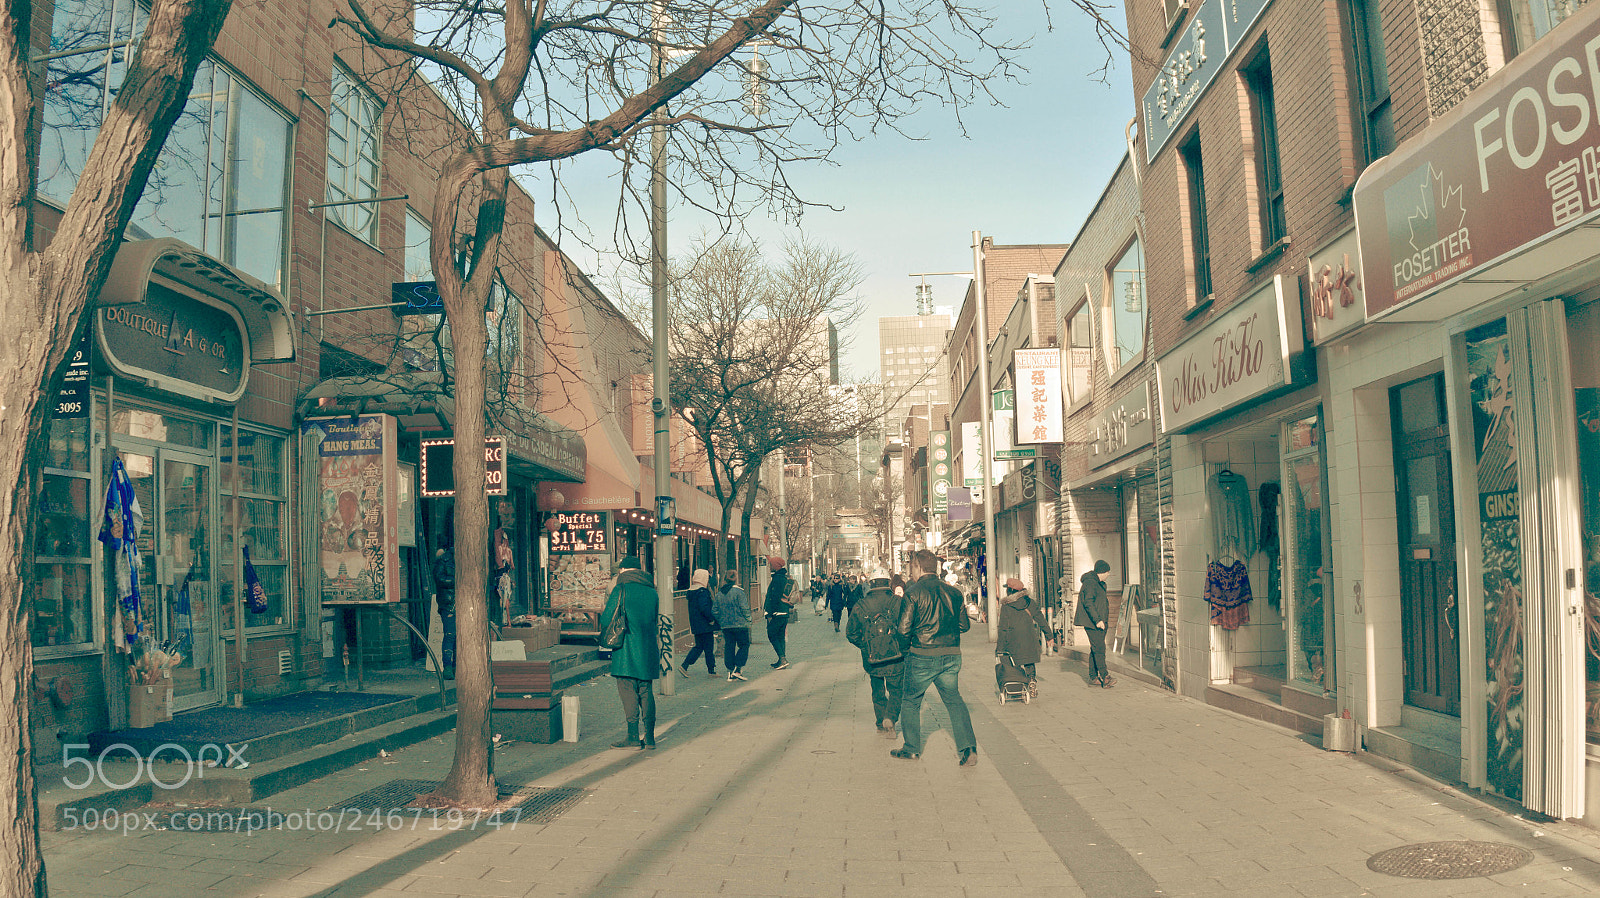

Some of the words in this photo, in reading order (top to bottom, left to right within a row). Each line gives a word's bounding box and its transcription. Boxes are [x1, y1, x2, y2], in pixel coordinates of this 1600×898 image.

[1394, 227, 1471, 286] FOSETTER
[1396, 274, 1434, 299] INTERNATIONAL
[1434, 263, 1458, 281] TRADING
[1459, 256, 1471, 269] INC.
[1016, 355, 1043, 366] KEUNG
[1044, 355, 1059, 365] KEE
[1172, 353, 1206, 413] Miss
[55, 402, 82, 413] -3095
[328, 424, 368, 434] Boutiq
[323, 440, 350, 452] HANG
[350, 439, 376, 450] MEAS
[519, 437, 530, 450] DU
[531, 438, 559, 460] CADEAU
[558, 513, 600, 524] Buffet
